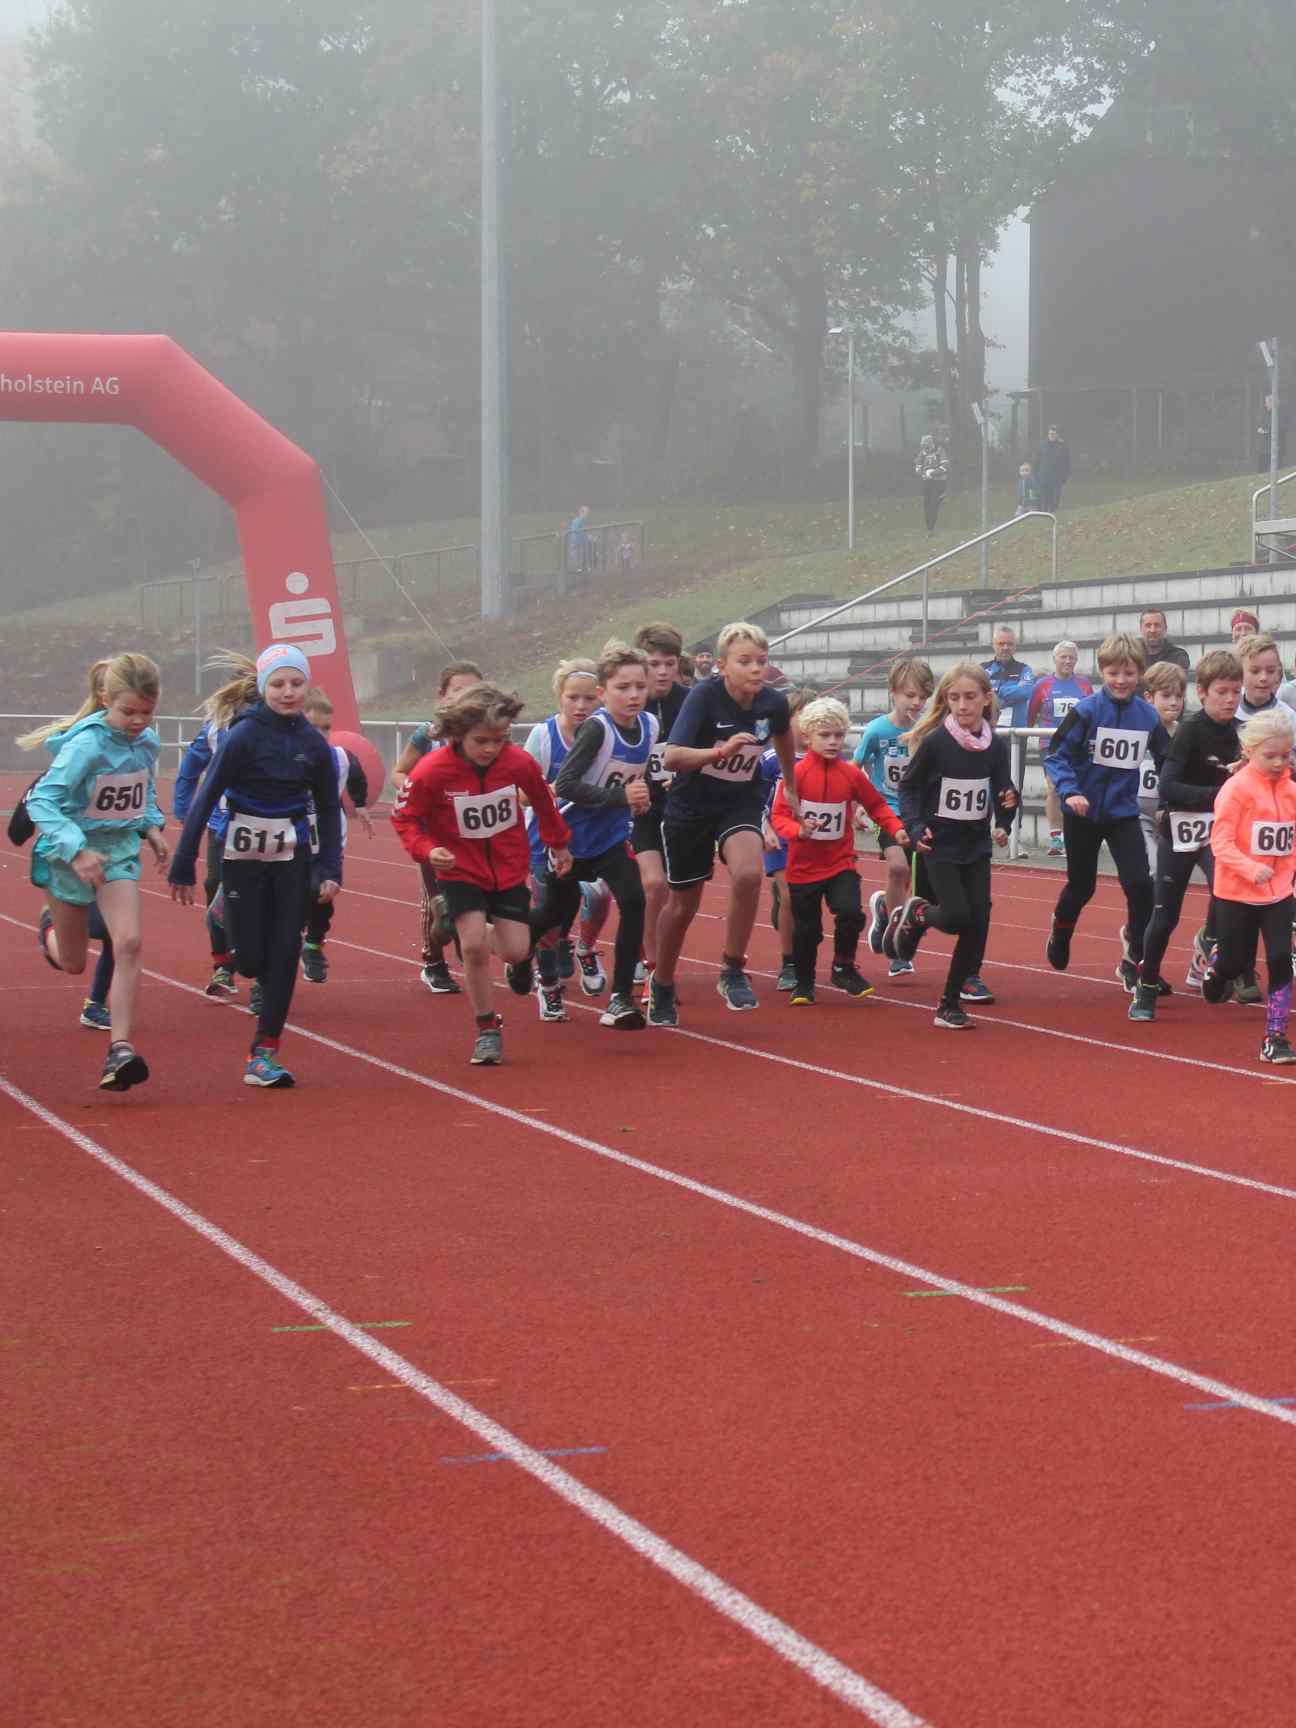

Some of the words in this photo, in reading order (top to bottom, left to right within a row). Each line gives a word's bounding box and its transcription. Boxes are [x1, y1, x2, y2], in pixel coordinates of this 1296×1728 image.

[0, 373, 85, 394] holstein
[91, 377, 120, 395] AG
[1101, 738, 1140, 761] 601
[95, 782, 144, 812] 650
[945, 789, 987, 812] 619
[463, 799, 512, 830] 608
[233, 826, 286, 854] 611
[1178, 820, 1214, 844] 62
[1258, 826, 1294, 852] 605
